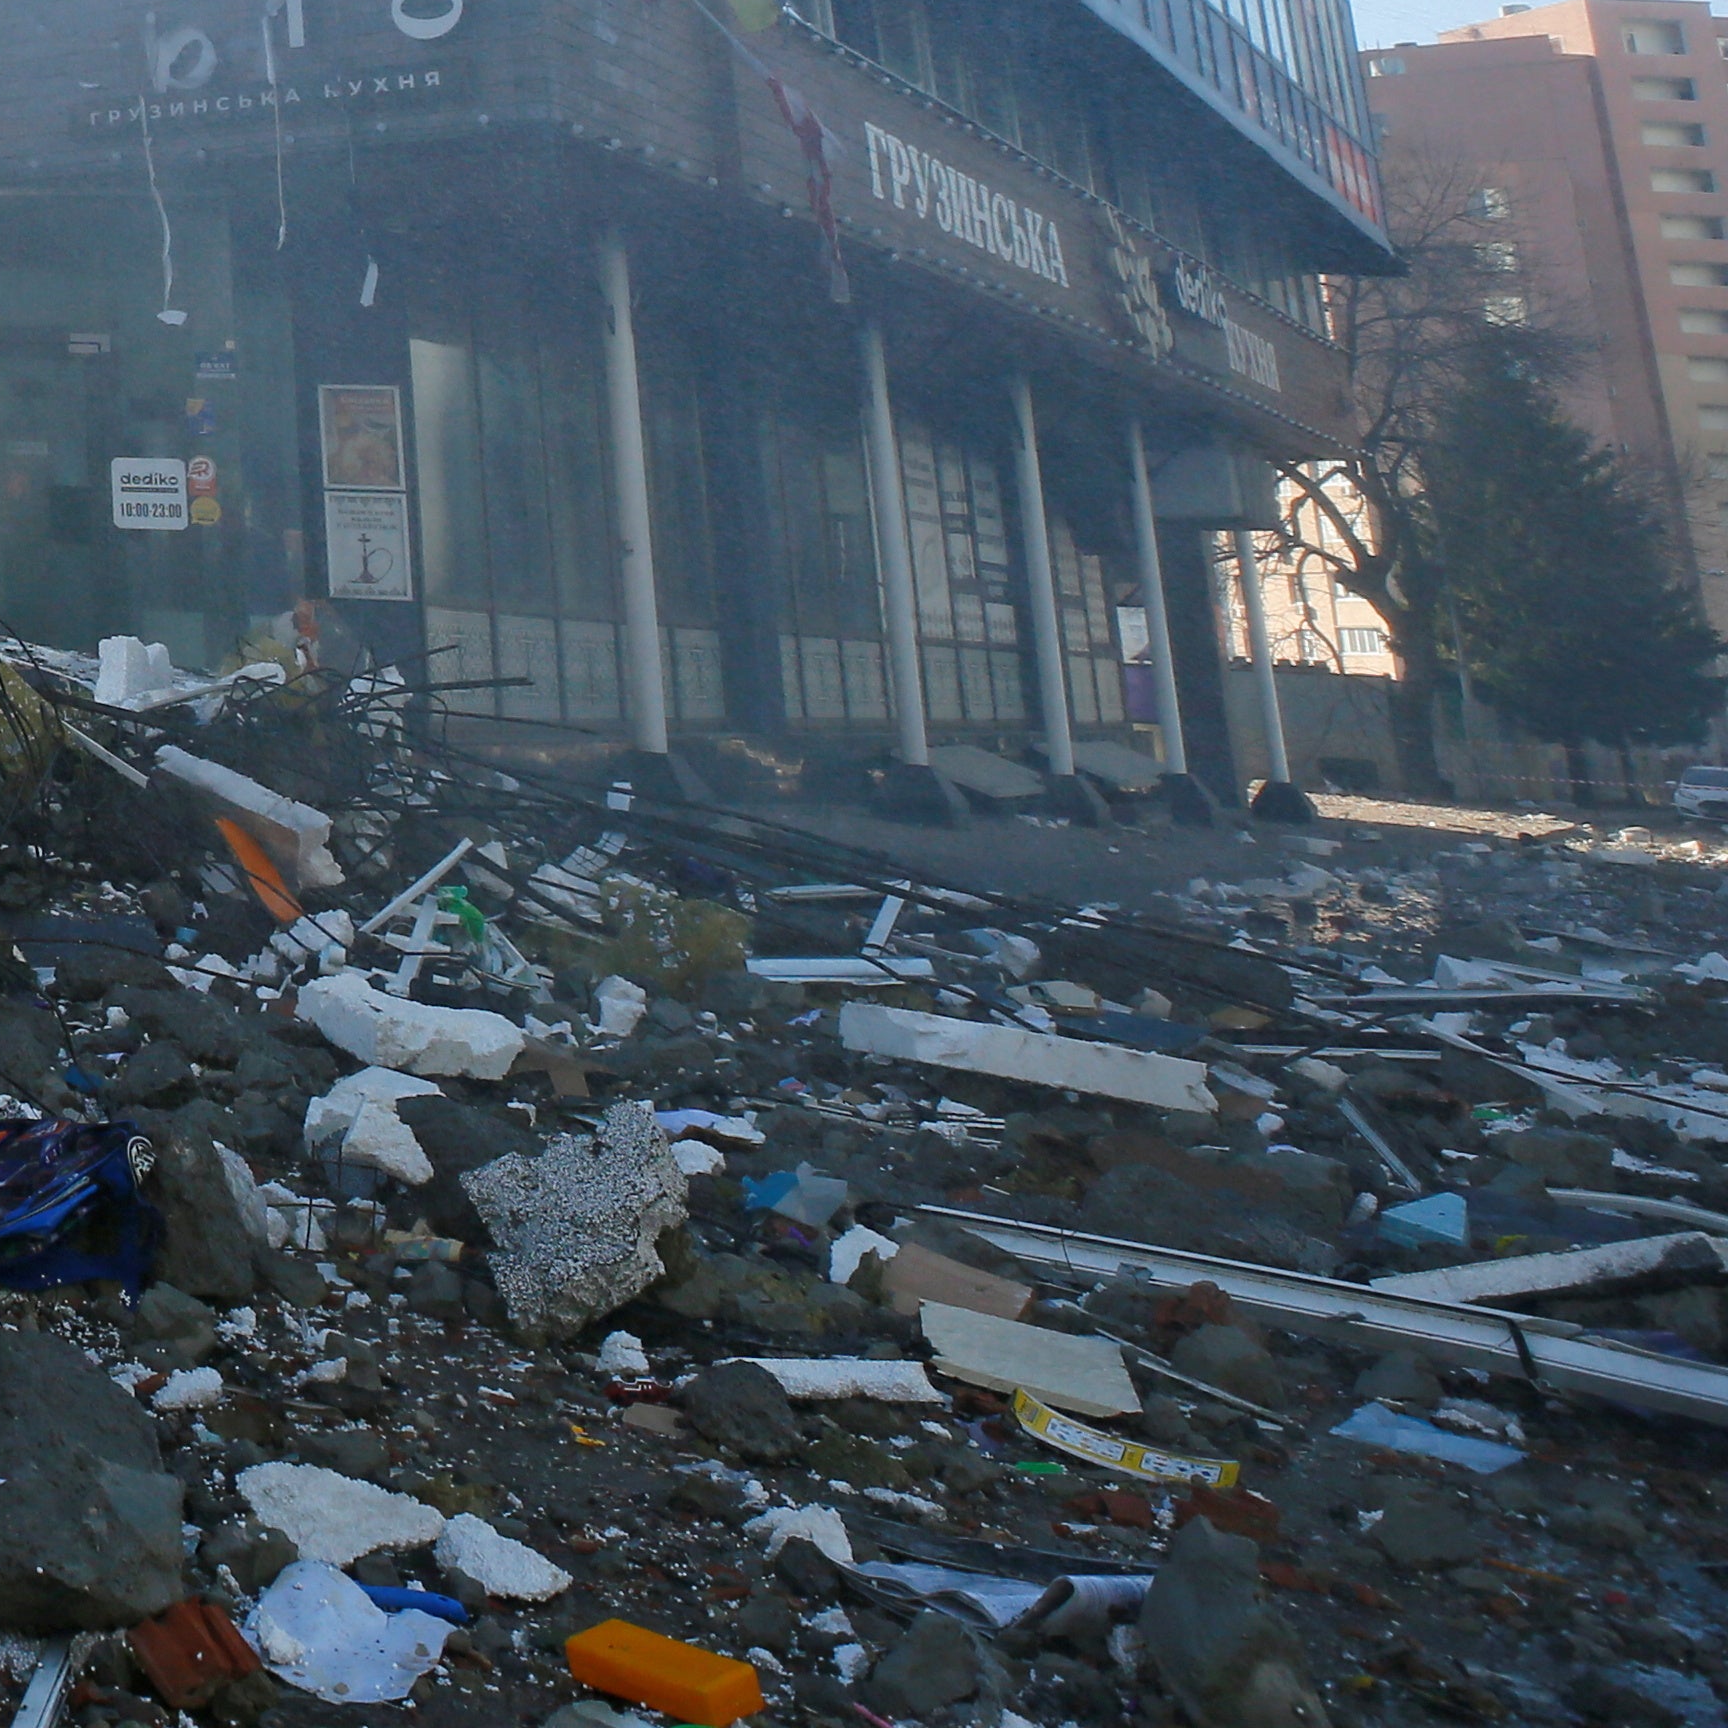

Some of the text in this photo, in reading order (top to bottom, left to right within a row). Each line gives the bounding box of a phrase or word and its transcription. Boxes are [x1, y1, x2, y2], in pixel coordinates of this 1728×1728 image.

[89, 70, 442, 126] ГРУЗИНСЬКА КУХНЯ
[864, 120, 1071, 289] ГРУЗИНСЬКА
[1224, 317, 1282, 393] КУХНЯ
[120, 472, 179, 486] dediko
[119, 502, 183, 519] 10:00-23:00
